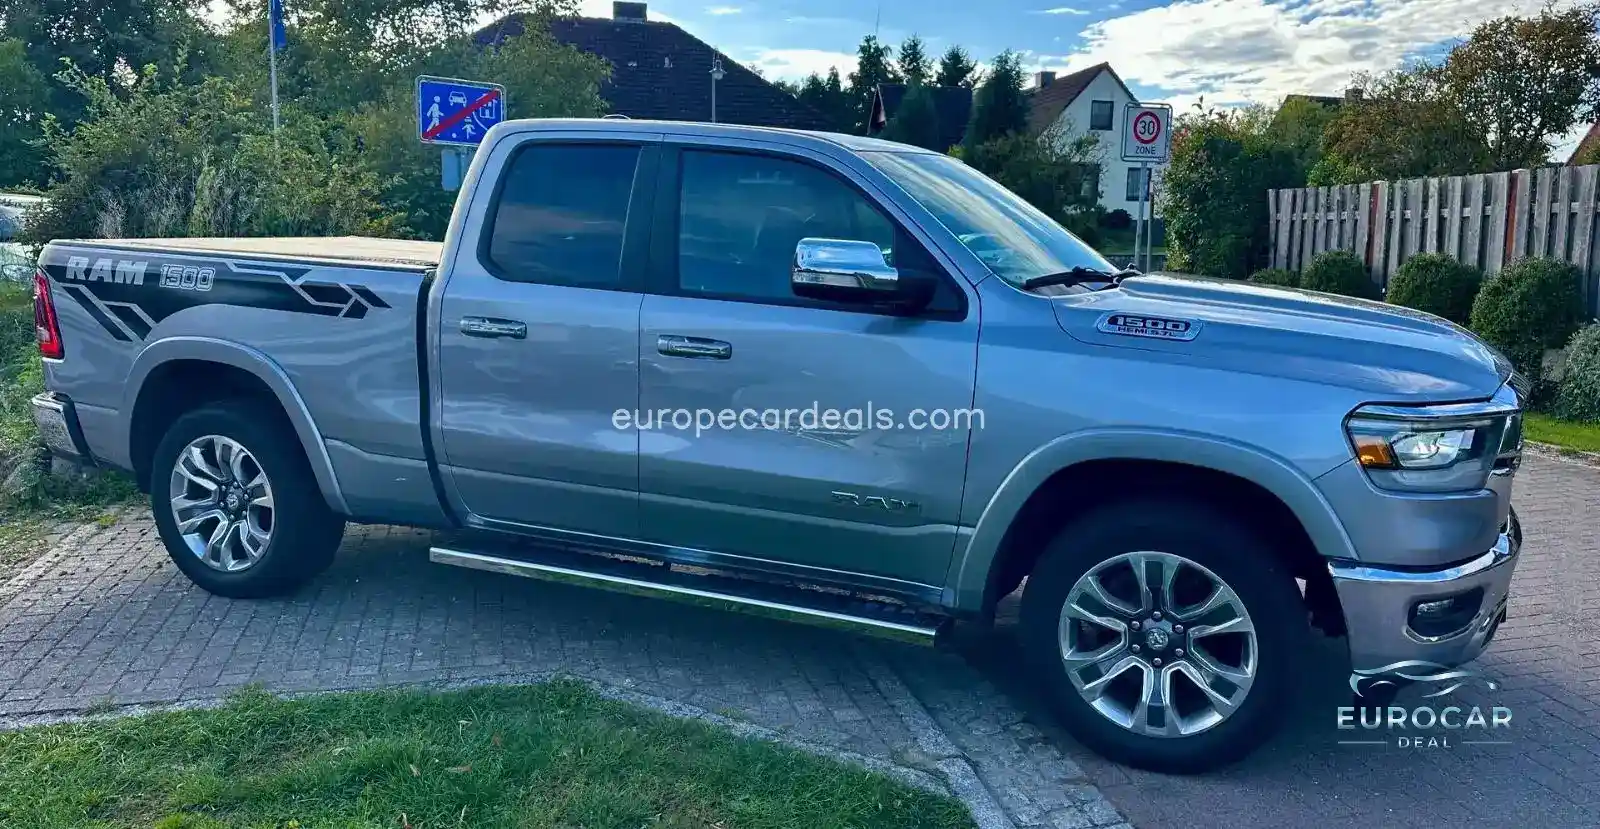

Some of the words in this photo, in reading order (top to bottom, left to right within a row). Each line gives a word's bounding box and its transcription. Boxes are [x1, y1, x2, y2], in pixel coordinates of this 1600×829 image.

[1139, 120, 1155, 135] 30
[1135, 145, 1156, 155] ZONE
[66, 256, 148, 286] RAM
[159, 263, 216, 291] 1500
[1116, 316, 1186, 331] 1500
[1117, 326, 1147, 336] HEMI
